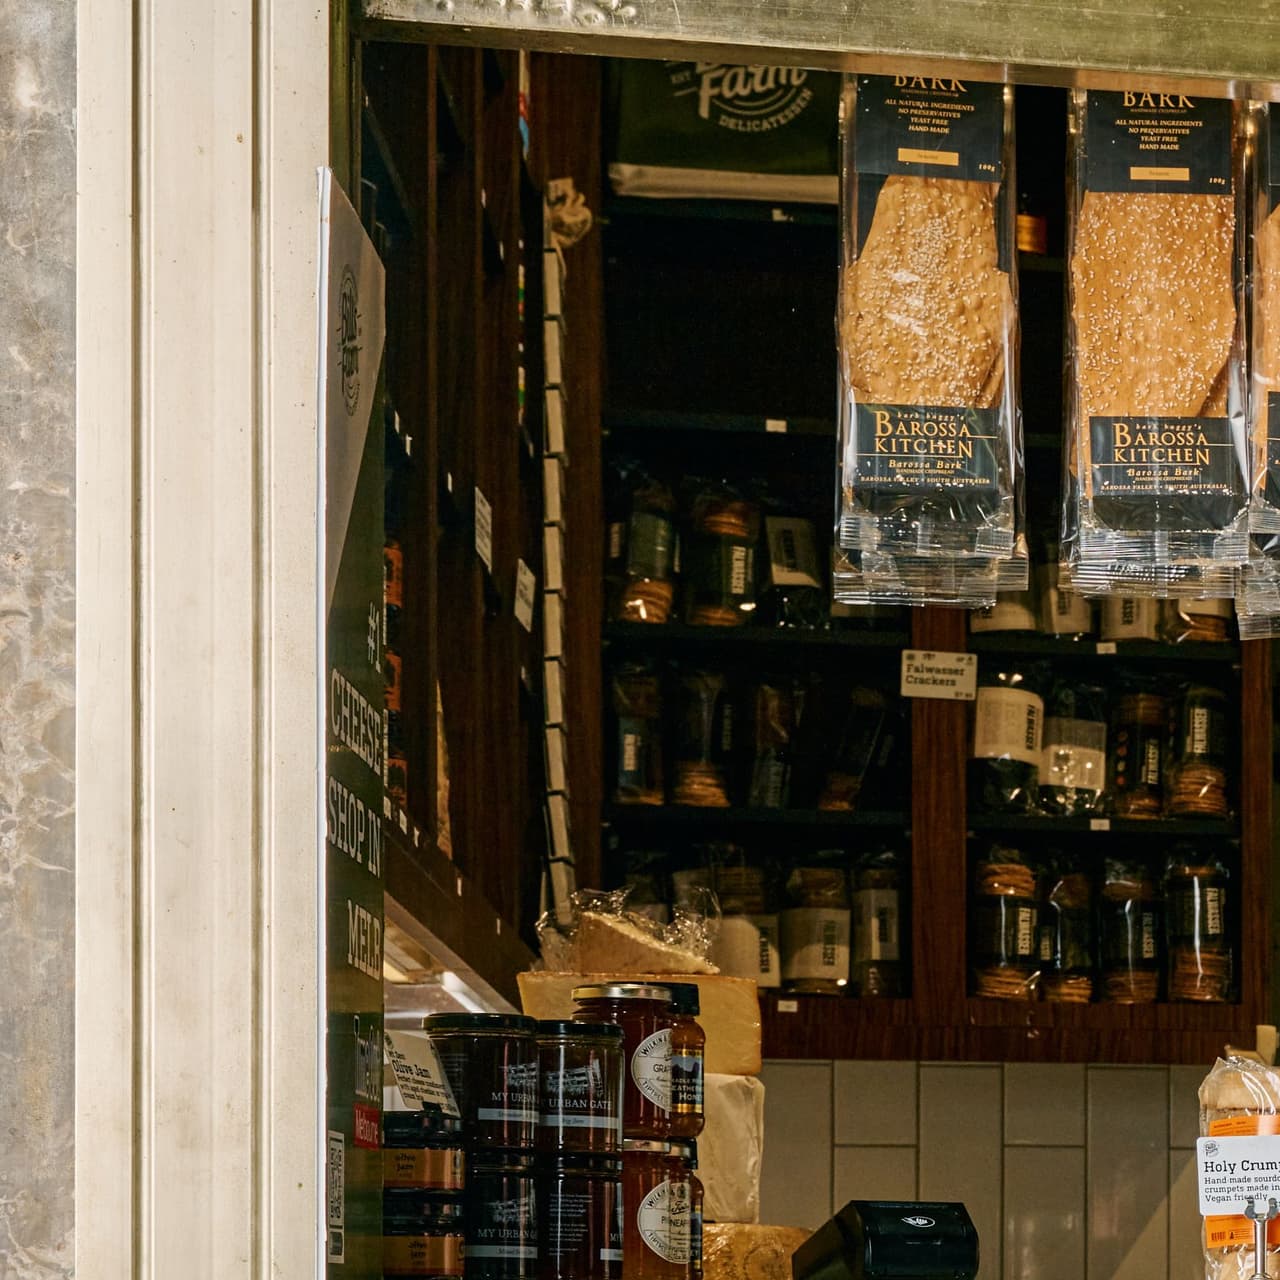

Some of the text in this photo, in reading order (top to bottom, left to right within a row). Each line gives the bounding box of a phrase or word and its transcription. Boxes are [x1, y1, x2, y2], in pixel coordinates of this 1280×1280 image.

[719, 88, 813, 131] DELICATESSEN
[874, 411, 971, 437] BAROSSA
[1113, 423, 1208, 446] BAROSSA
[875, 438, 973, 458] KITCHEN
[1115, 449, 1209, 465] KITCHEN
[906, 664, 965, 676] Falwasser
[906, 675, 957, 686] Crackers
[331, 667, 382, 777] CHEESE
[328, 776, 381, 879] SHOP IN
[347, 898, 381, 981] MELB
[1204, 1160, 1236, 1174] Holy
